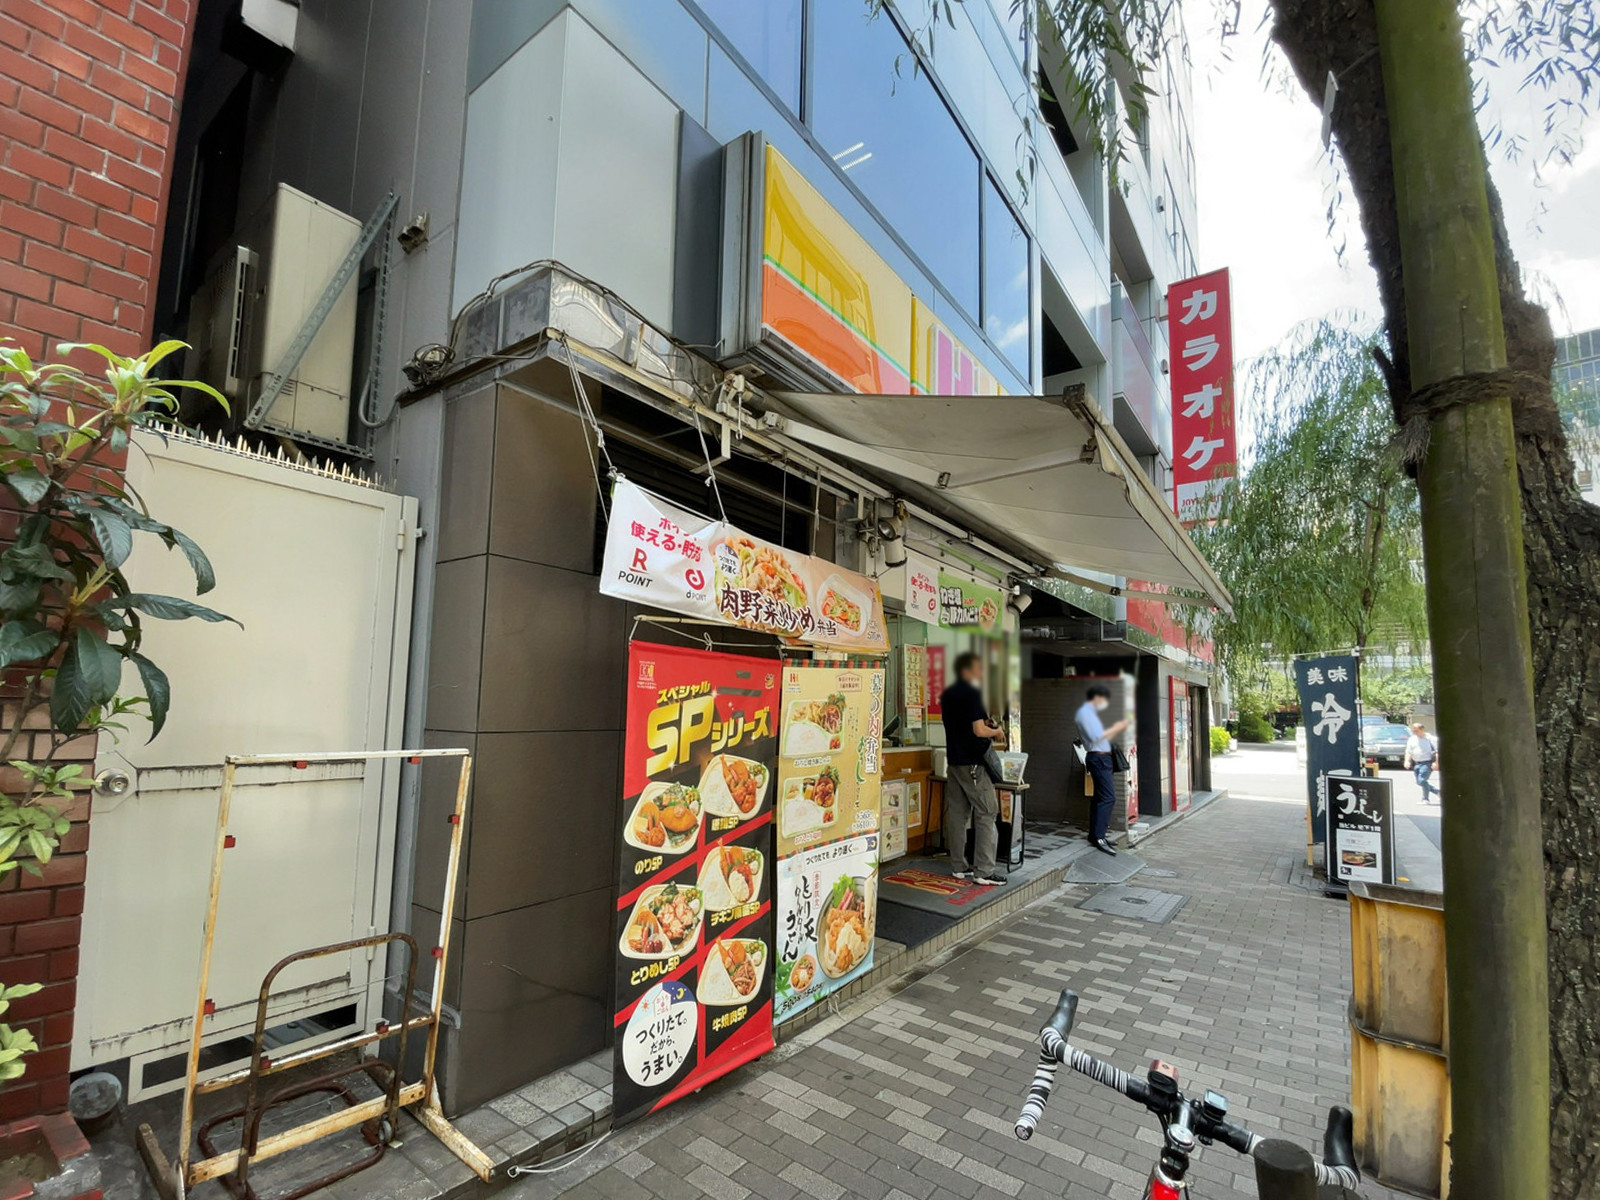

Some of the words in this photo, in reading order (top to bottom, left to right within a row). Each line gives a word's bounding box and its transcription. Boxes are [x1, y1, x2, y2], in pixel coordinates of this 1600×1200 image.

[1180, 289, 1224, 471] カラオケ
[618, 571, 653, 588] POINT
[720, 581, 838, 637] 肉野菜炒め弁当
[1307, 665, 1348, 686] 美味
[657, 681, 711, 704] スペシャル
[646, 695, 770, 777] SPシリーズ
[634, 856, 663, 875] のりSP
[630, 955, 681, 986] とりめしSP
[635, 1010, 687, 1045] つくりたて。
[711, 1005, 748, 1032] 牛焼肉SP
[650, 1035, 676, 1055] だから、
[641, 1050, 683, 1082] うまい。
